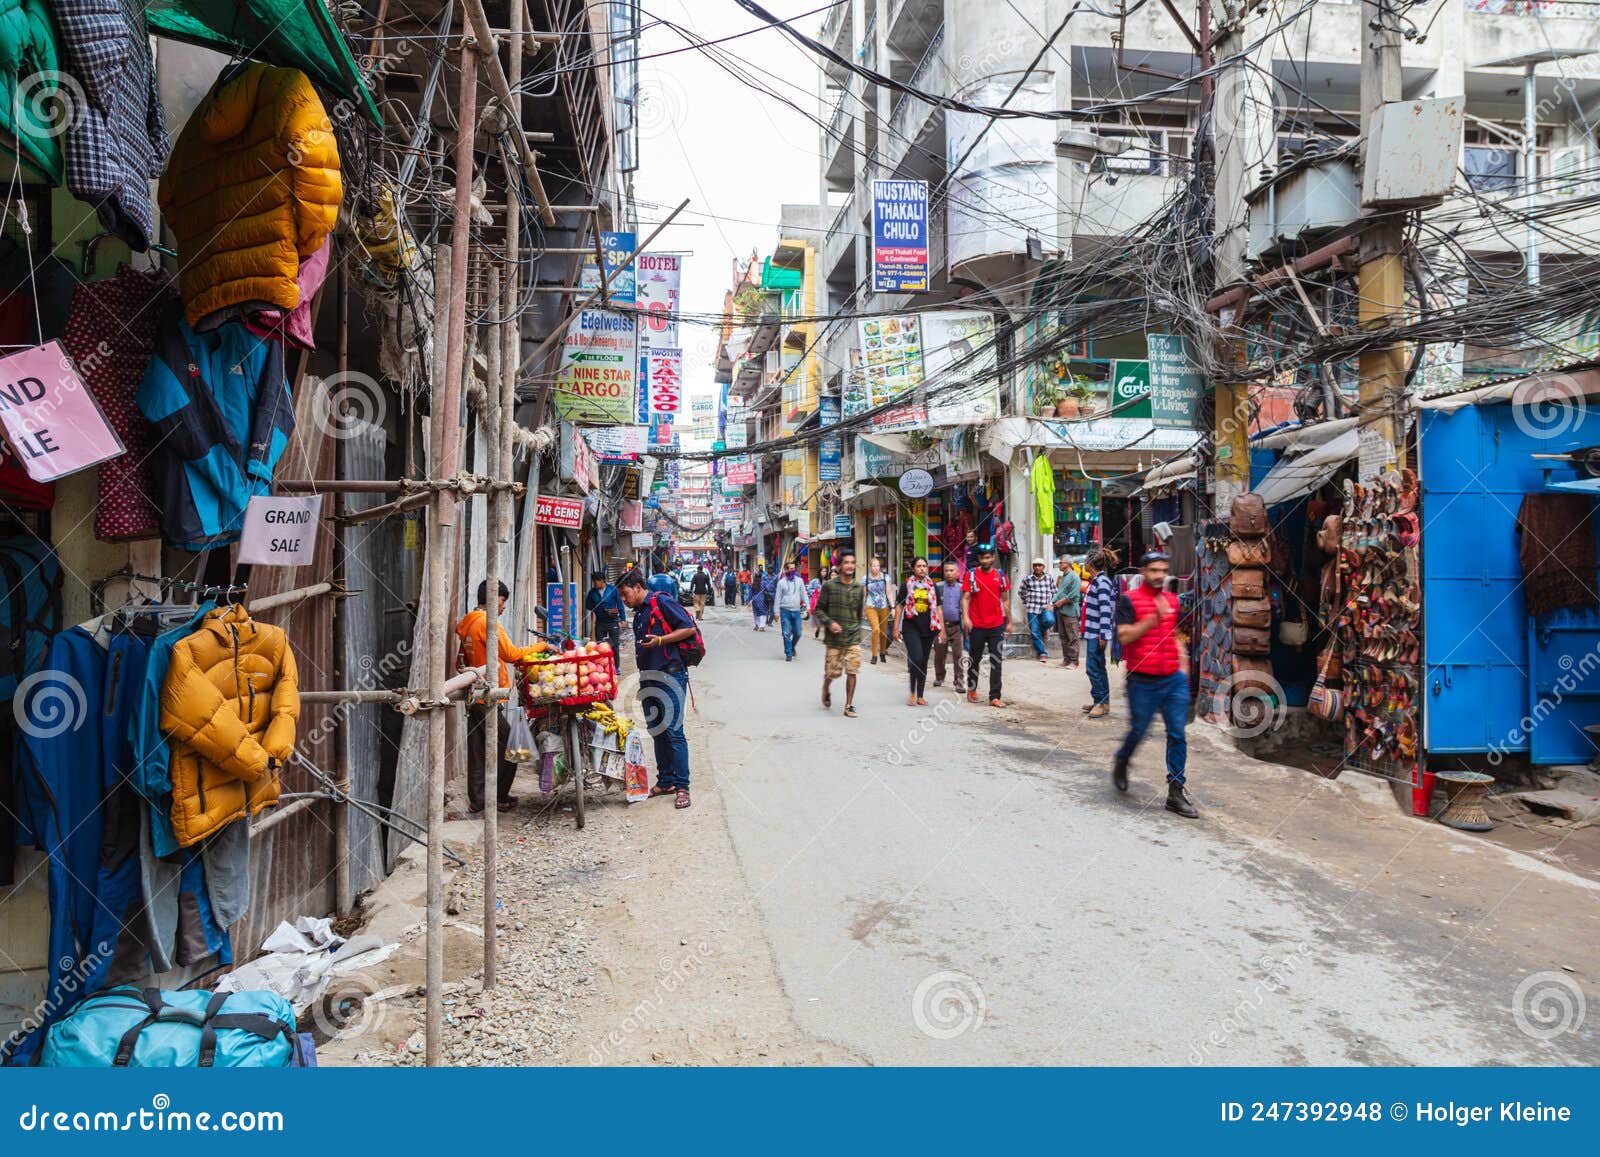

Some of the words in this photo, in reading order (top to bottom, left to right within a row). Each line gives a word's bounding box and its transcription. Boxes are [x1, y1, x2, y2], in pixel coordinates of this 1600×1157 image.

[875, 182, 926, 201] MUSTANG
[878, 202, 924, 220] THAKALI
[883, 221, 919, 240] CHULO
[608, 250, 634, 266] SPA
[640, 256, 679, 271] HOTEL
[581, 311, 634, 331] Edelweiss
[574, 367, 600, 380] NINE
[603, 368, 632, 381] STAR
[558, 381, 621, 397] CARGO
[265, 510, 311, 524] GRAND
[554, 506, 581, 520] GEMS
[270, 538, 301, 552] SALE
